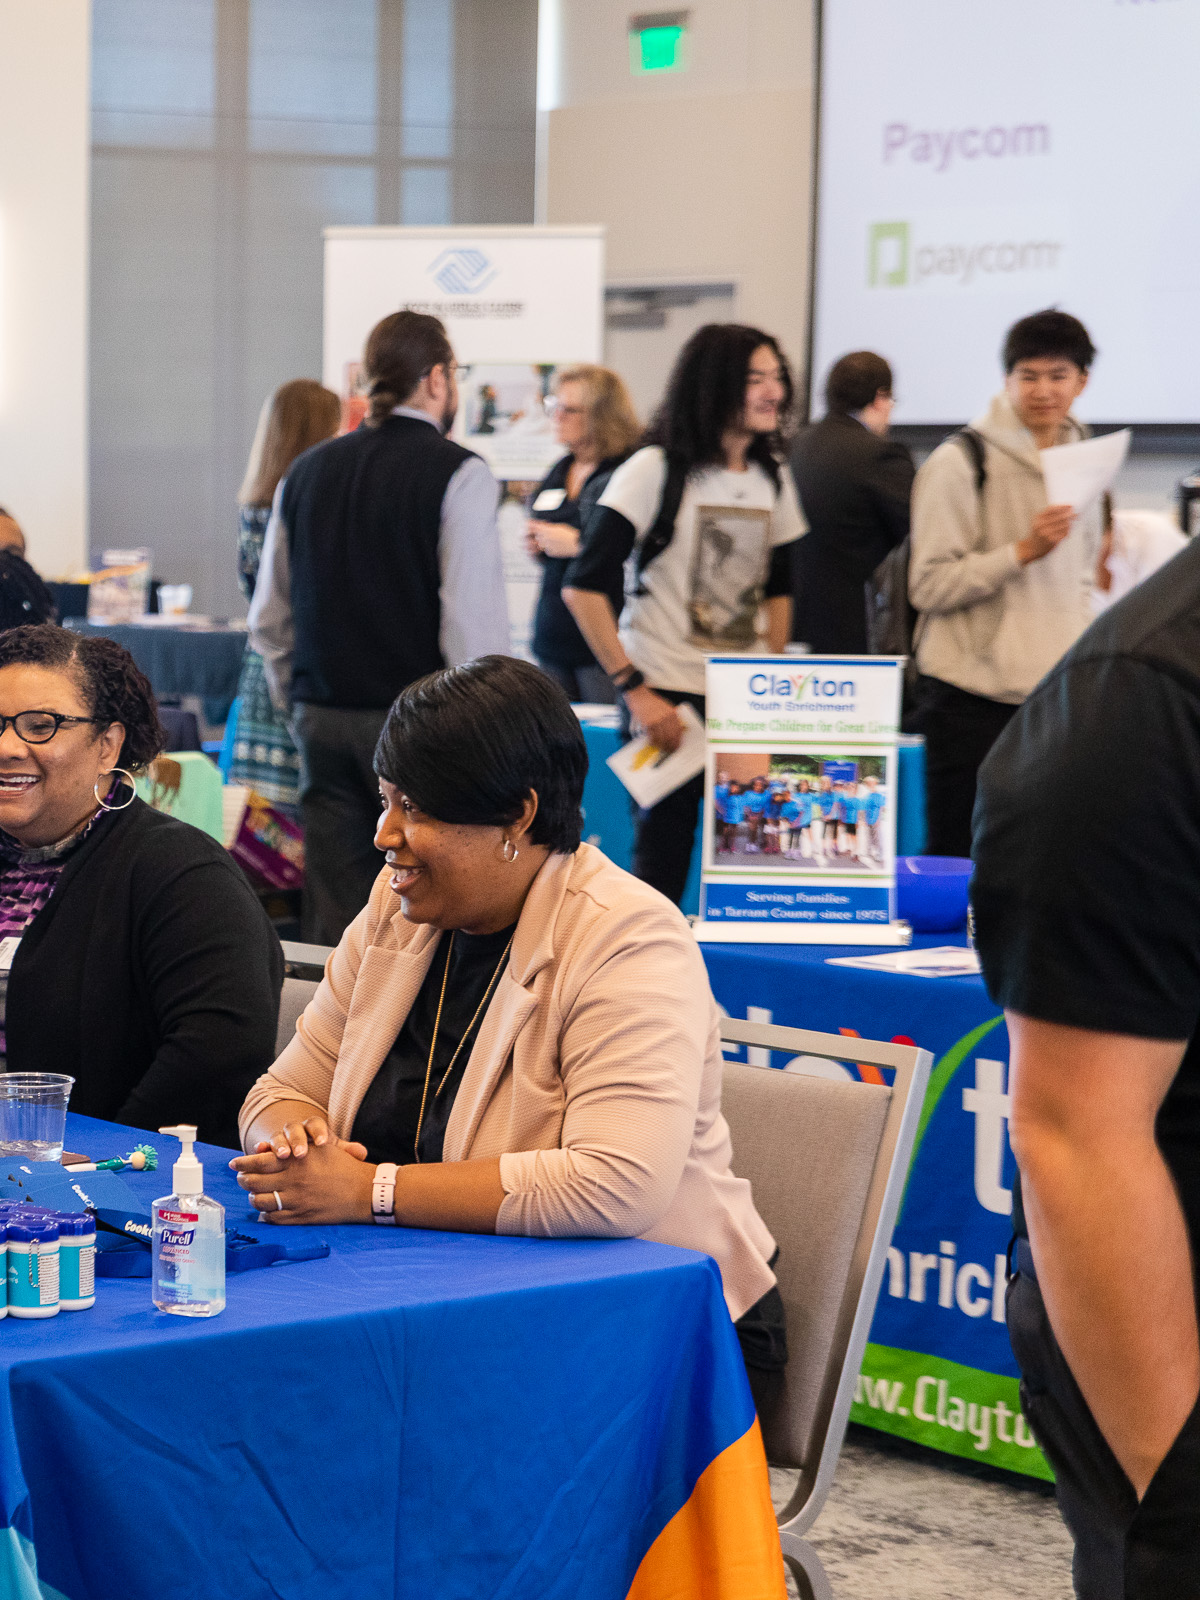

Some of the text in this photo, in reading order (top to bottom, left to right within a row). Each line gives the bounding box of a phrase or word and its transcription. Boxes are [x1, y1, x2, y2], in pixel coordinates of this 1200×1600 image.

[881, 121, 1051, 172] Paycom
[749, 668, 856, 700] Clayton
[748, 700, 856, 712] Youth Enrichment
[726, 718, 766, 733] Prepare
[769, 720, 814, 732] Children
[818, 721, 832, 733] for
[835, 721, 864, 733] Great
[745, 891, 850, 905] Serving Families
[707, 905, 888, 921] in Tarrant County since 1975
[162, 1230, 191, 1245] Purell
